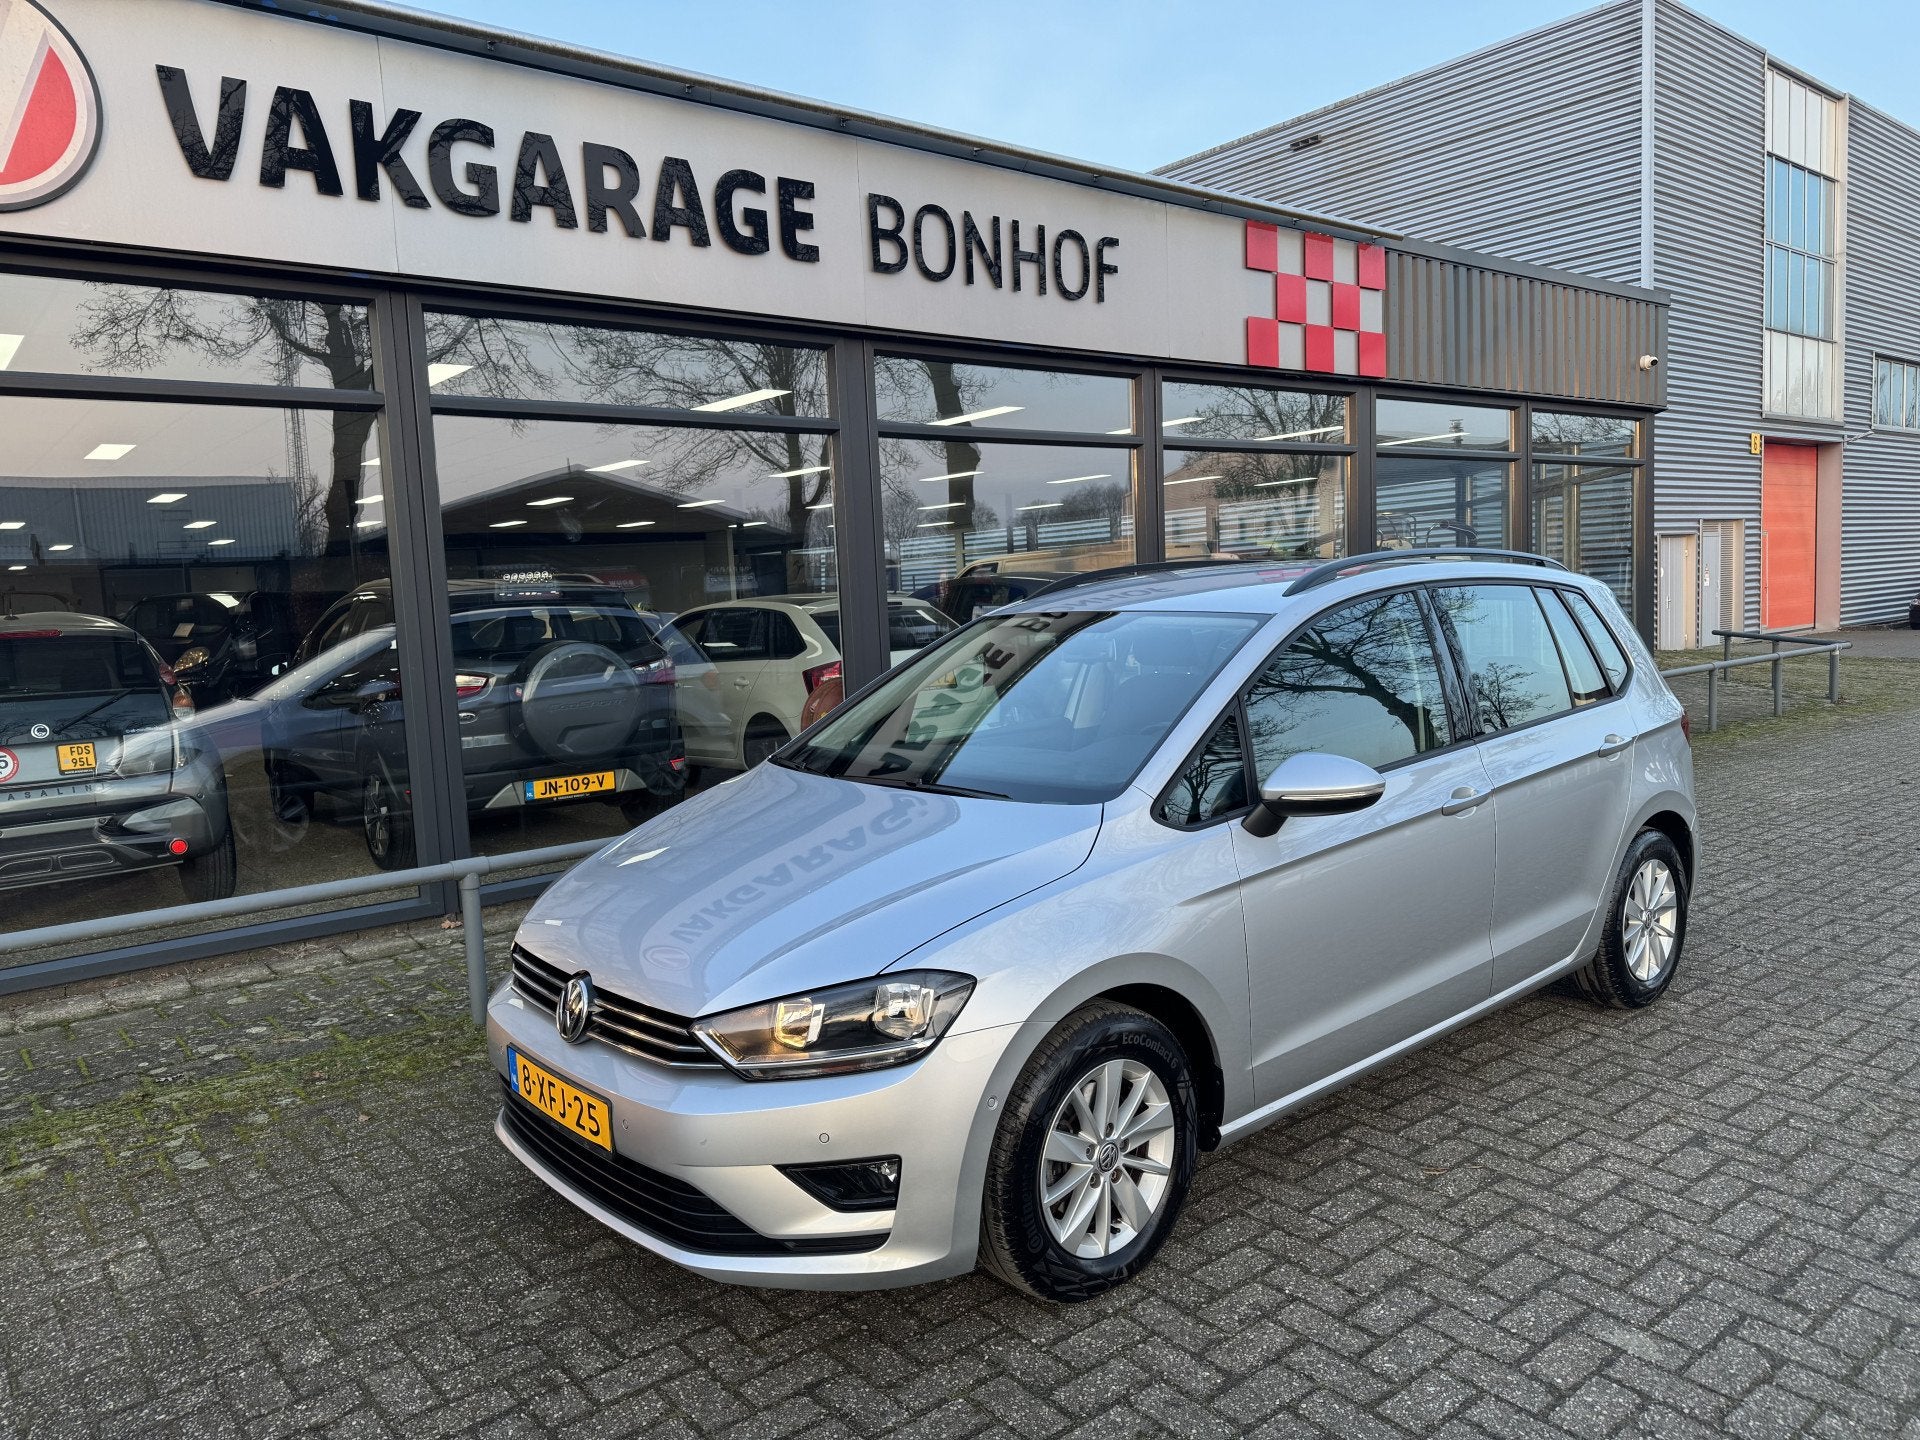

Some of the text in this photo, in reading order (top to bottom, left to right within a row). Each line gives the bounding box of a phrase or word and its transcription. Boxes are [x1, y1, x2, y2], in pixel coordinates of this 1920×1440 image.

[155, 64, 1120, 303] VAKGARAGE BONHOF
[70, 745, 91, 756] FDS
[71, 757, 93, 767] 95L
[540, 774, 605, 796] JN-109-V
[1121, 1031, 1179, 1069] EcoContact 6
[522, 1063, 601, 1137] 8-XFJ-25
